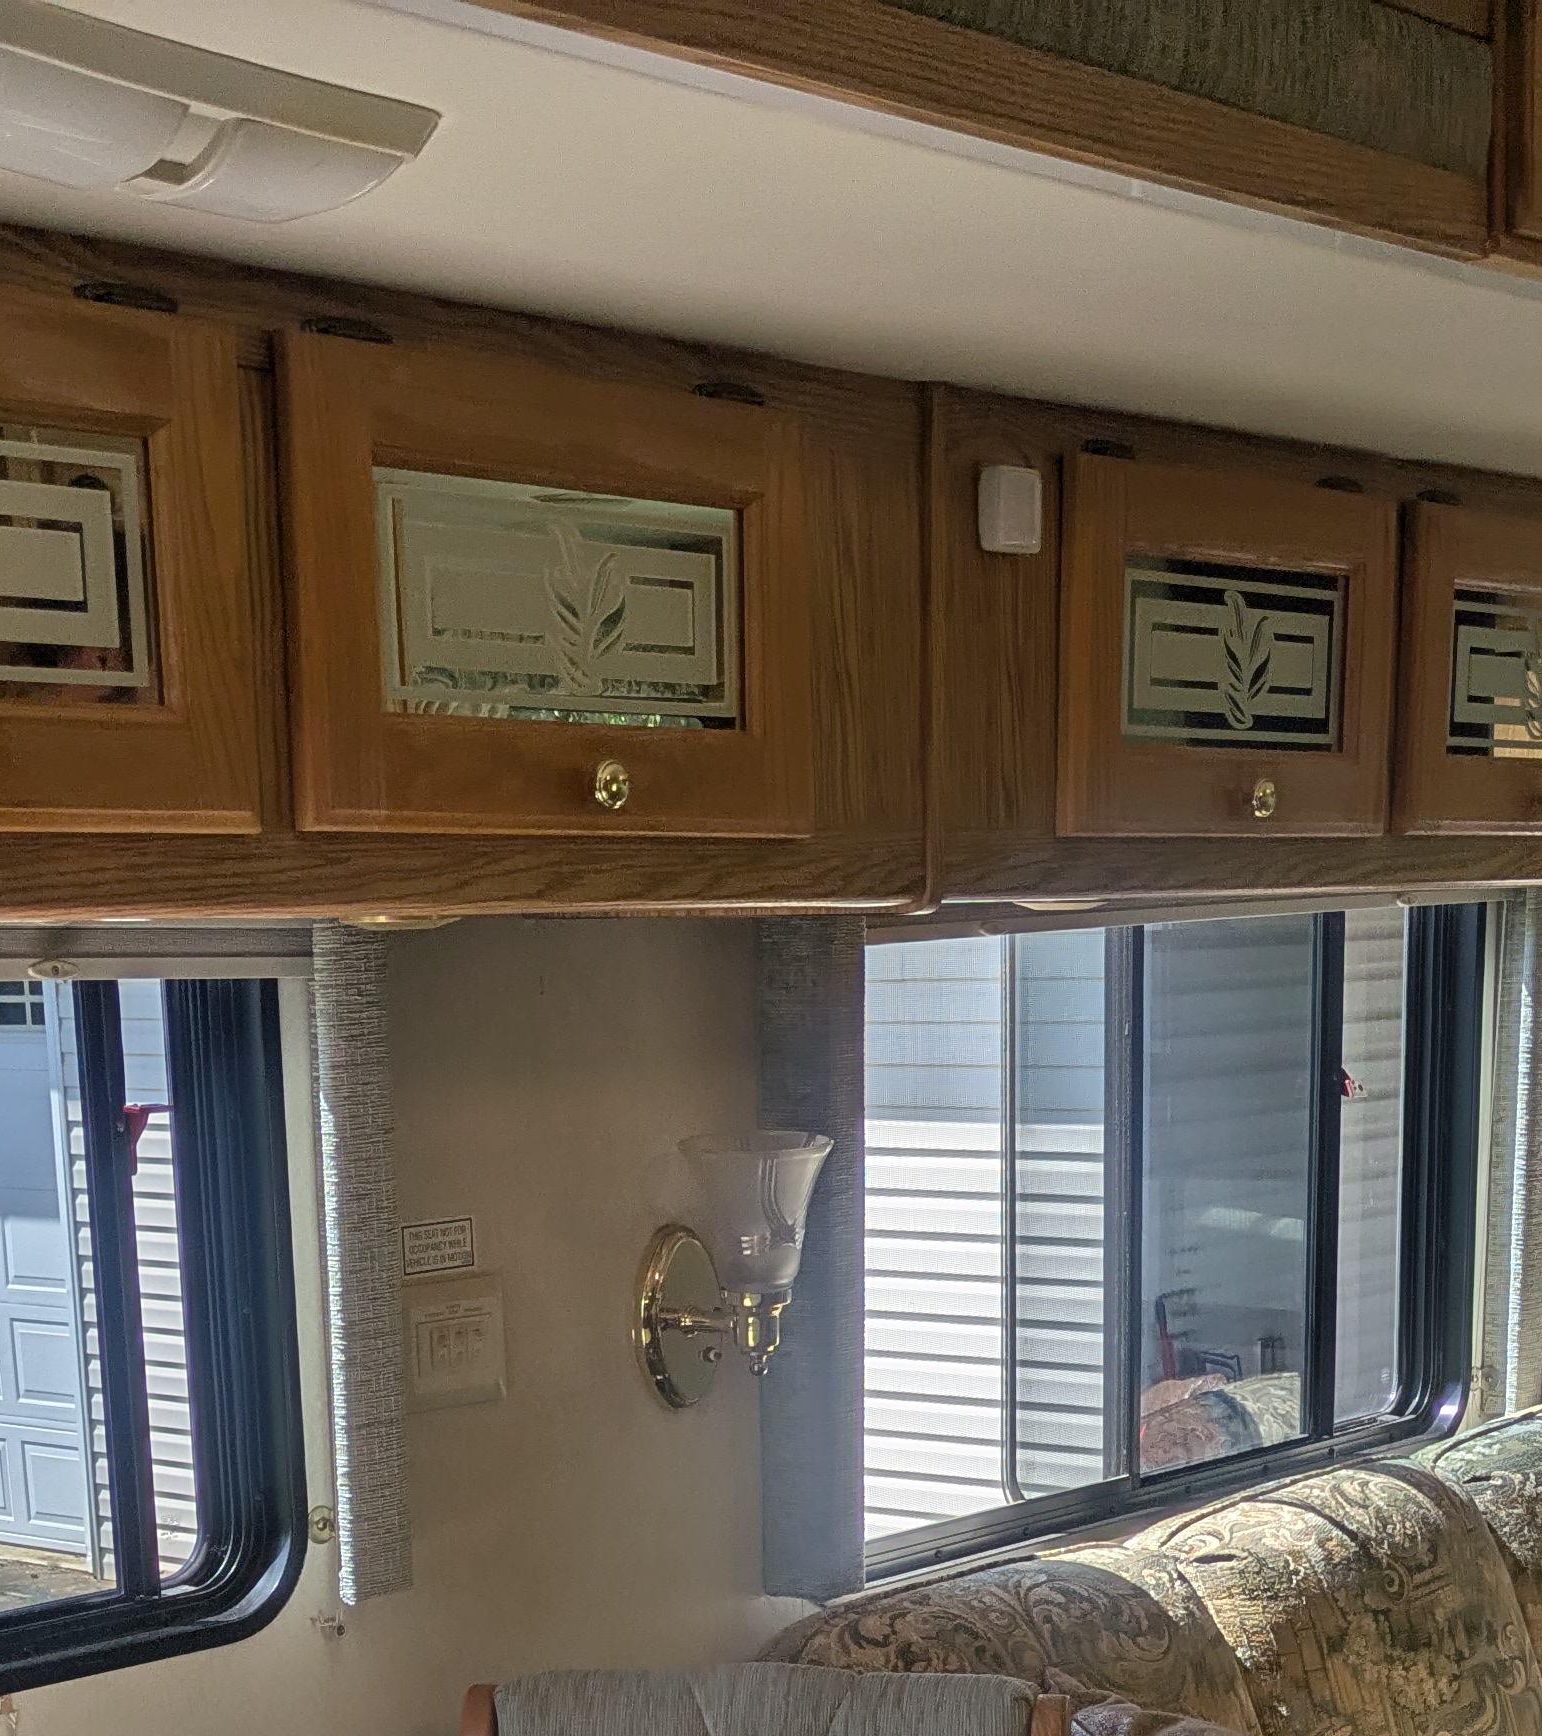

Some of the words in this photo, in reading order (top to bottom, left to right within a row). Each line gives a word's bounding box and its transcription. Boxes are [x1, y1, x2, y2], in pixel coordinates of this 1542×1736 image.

[454, 1224, 467, 1235] FOR
[409, 1241, 447, 1255] OCCUPANCY
[448, 1237, 467, 1249] WHILE
[405, 1255, 431, 1268] VEHICLE
